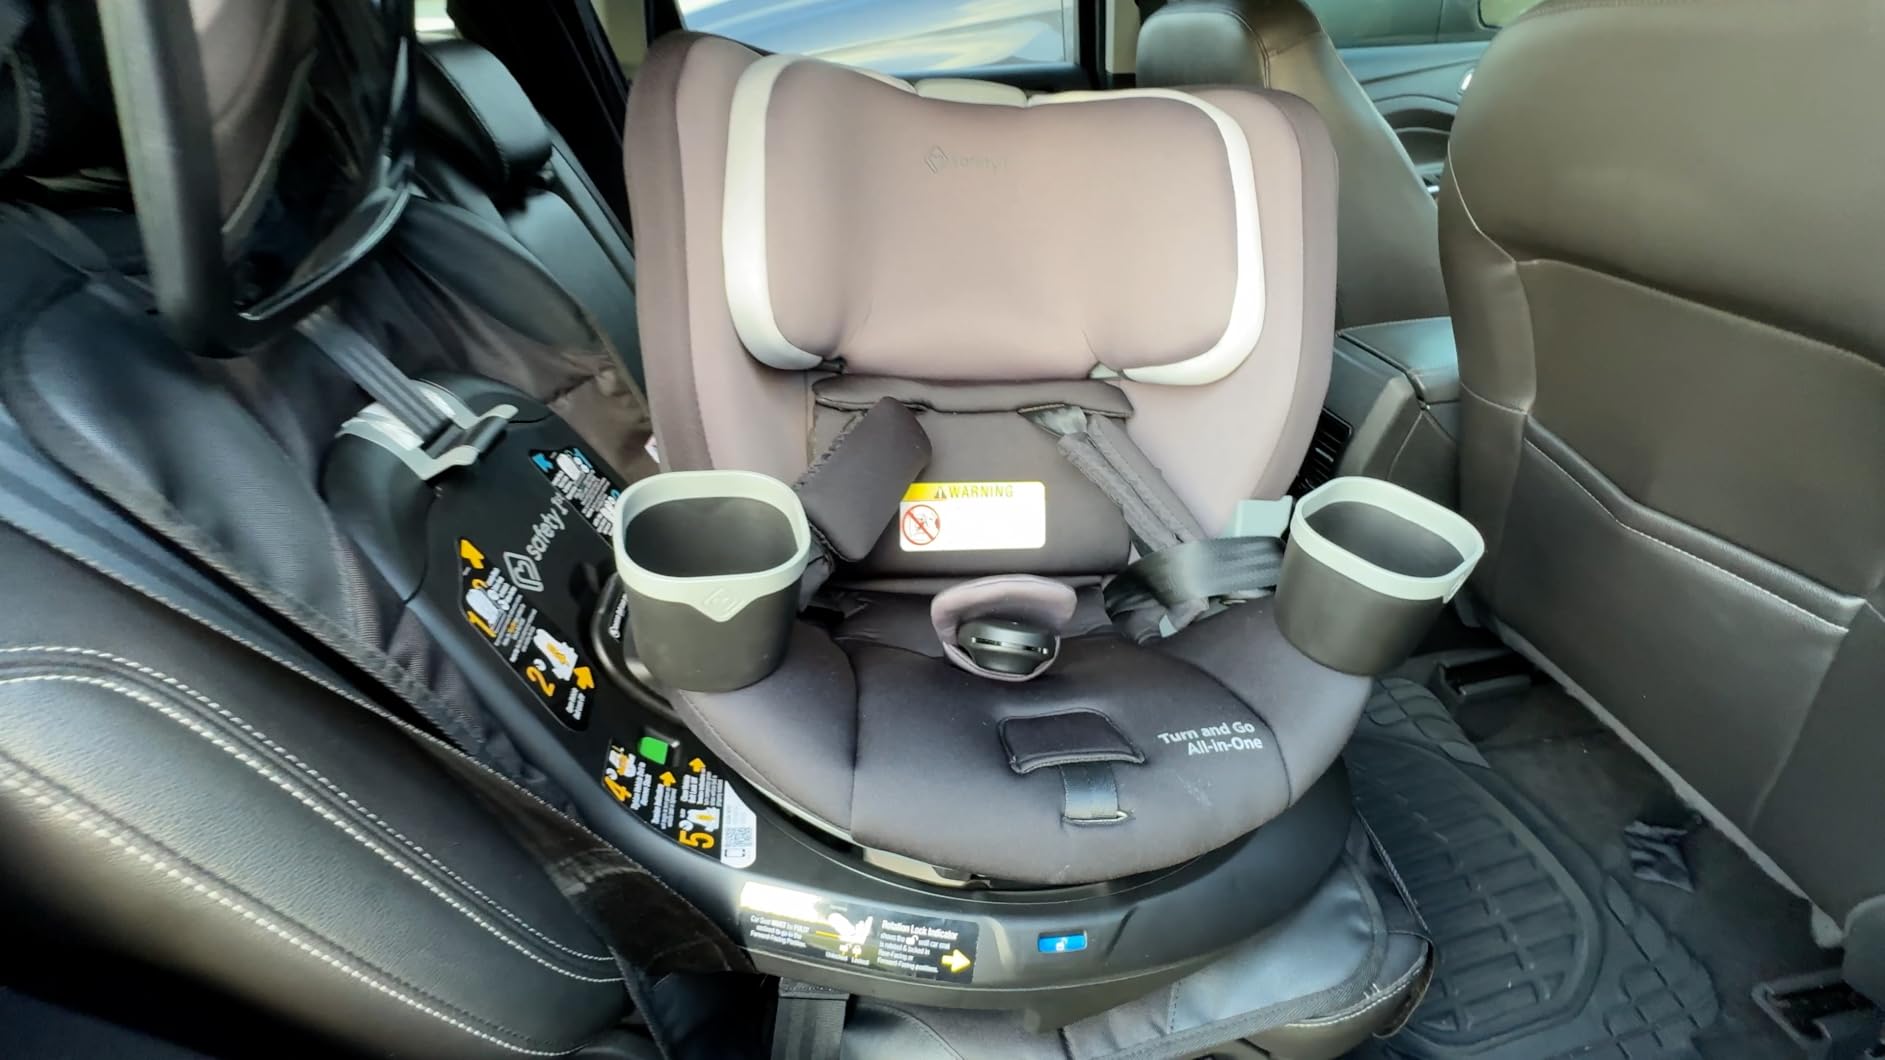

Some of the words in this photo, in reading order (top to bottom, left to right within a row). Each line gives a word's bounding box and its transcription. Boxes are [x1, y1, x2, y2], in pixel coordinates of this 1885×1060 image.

[949, 484, 1013, 498] WARNING
[525, 507, 565, 561] safety
[466, 610, 497, 638] 1
[526, 665, 556, 697] 2
[1157, 729, 1199, 744] Turn
[1200, 722, 1231, 737] and
[1231, 721, 1255, 733] Go
[1187, 736, 1263, 756] All-in-One
[604, 775, 632, 802] 4
[679, 830, 715, 849] 5
[910, 924, 928, 936] Lock
[927, 927, 959, 940] Indicator
